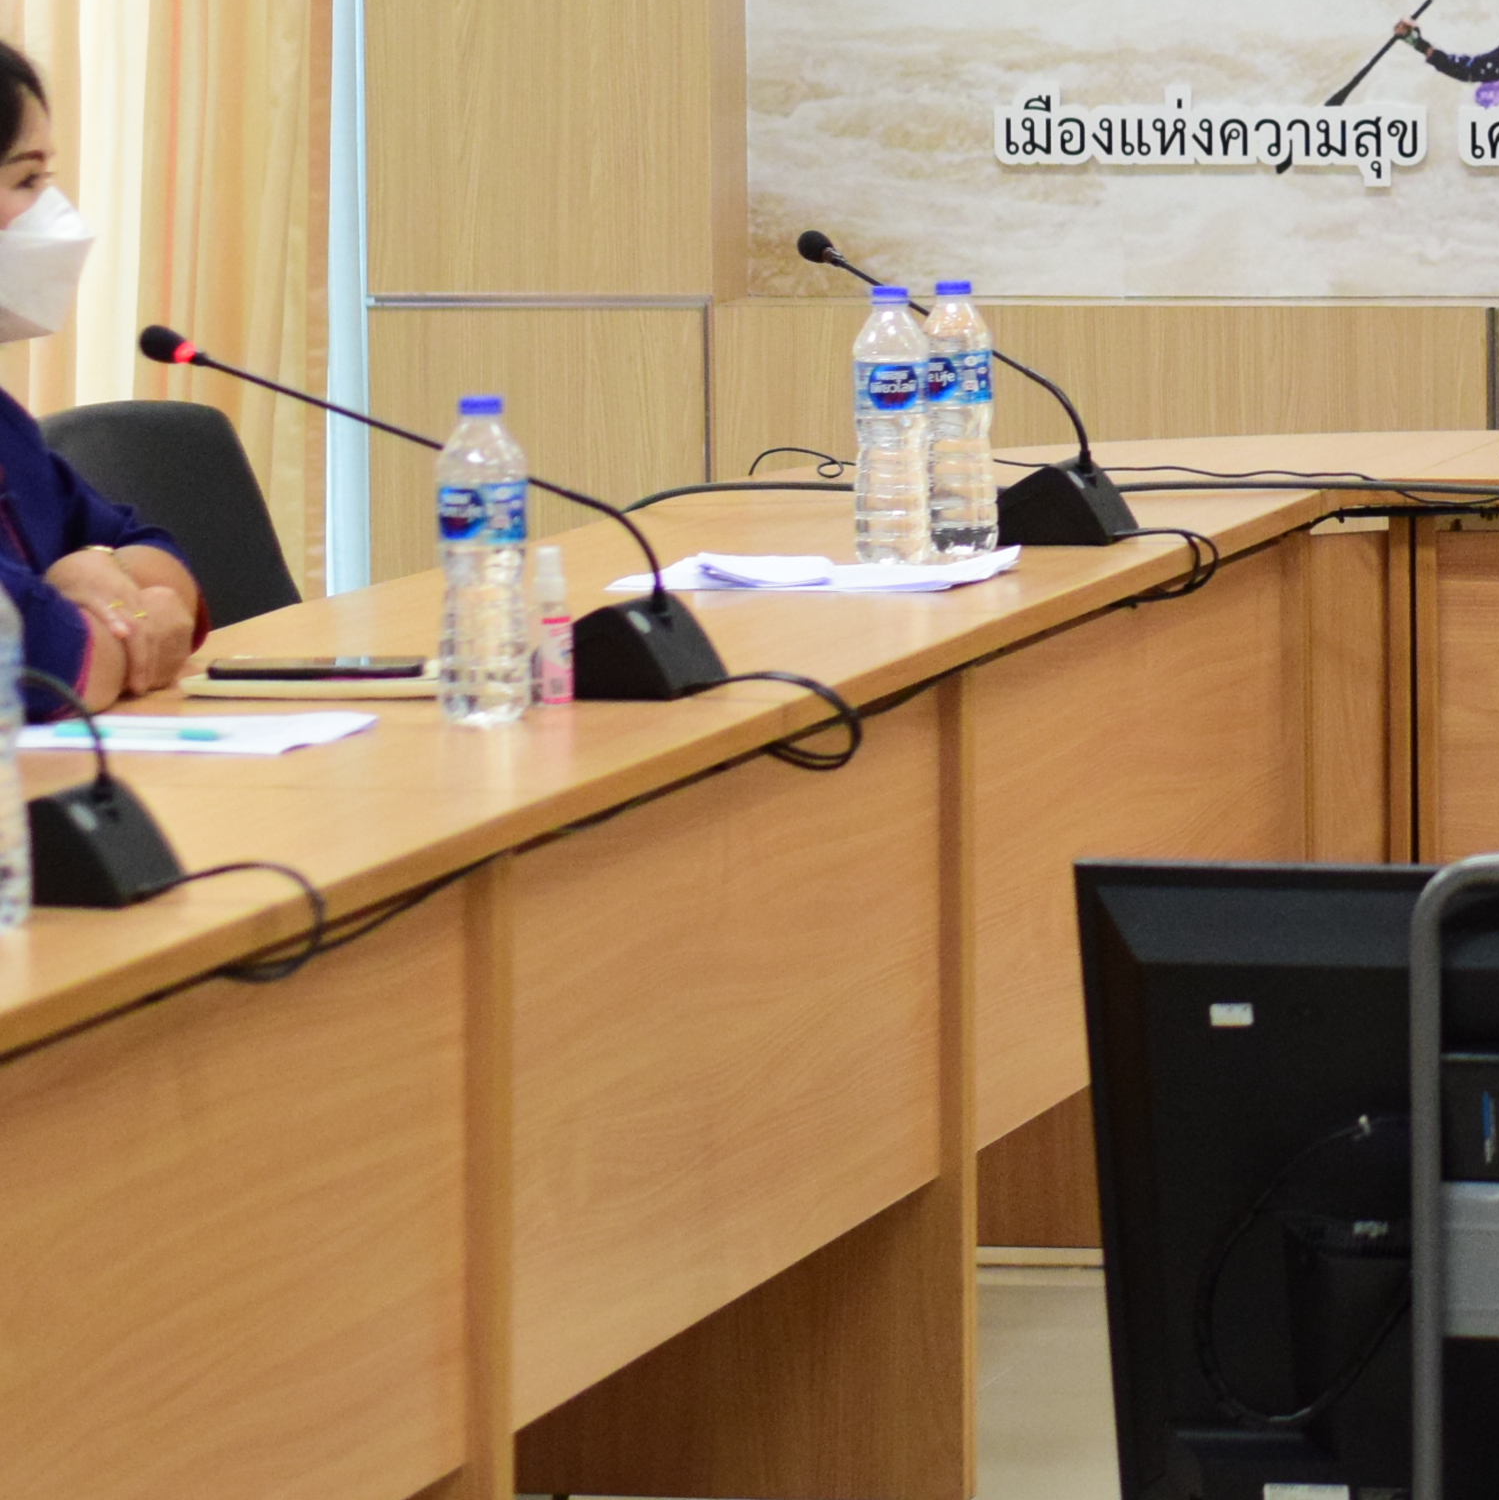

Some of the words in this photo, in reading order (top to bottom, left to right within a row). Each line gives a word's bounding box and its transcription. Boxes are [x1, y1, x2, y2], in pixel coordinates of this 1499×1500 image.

[1004, 94, 1419, 180] เมืองแห่งความสุข
